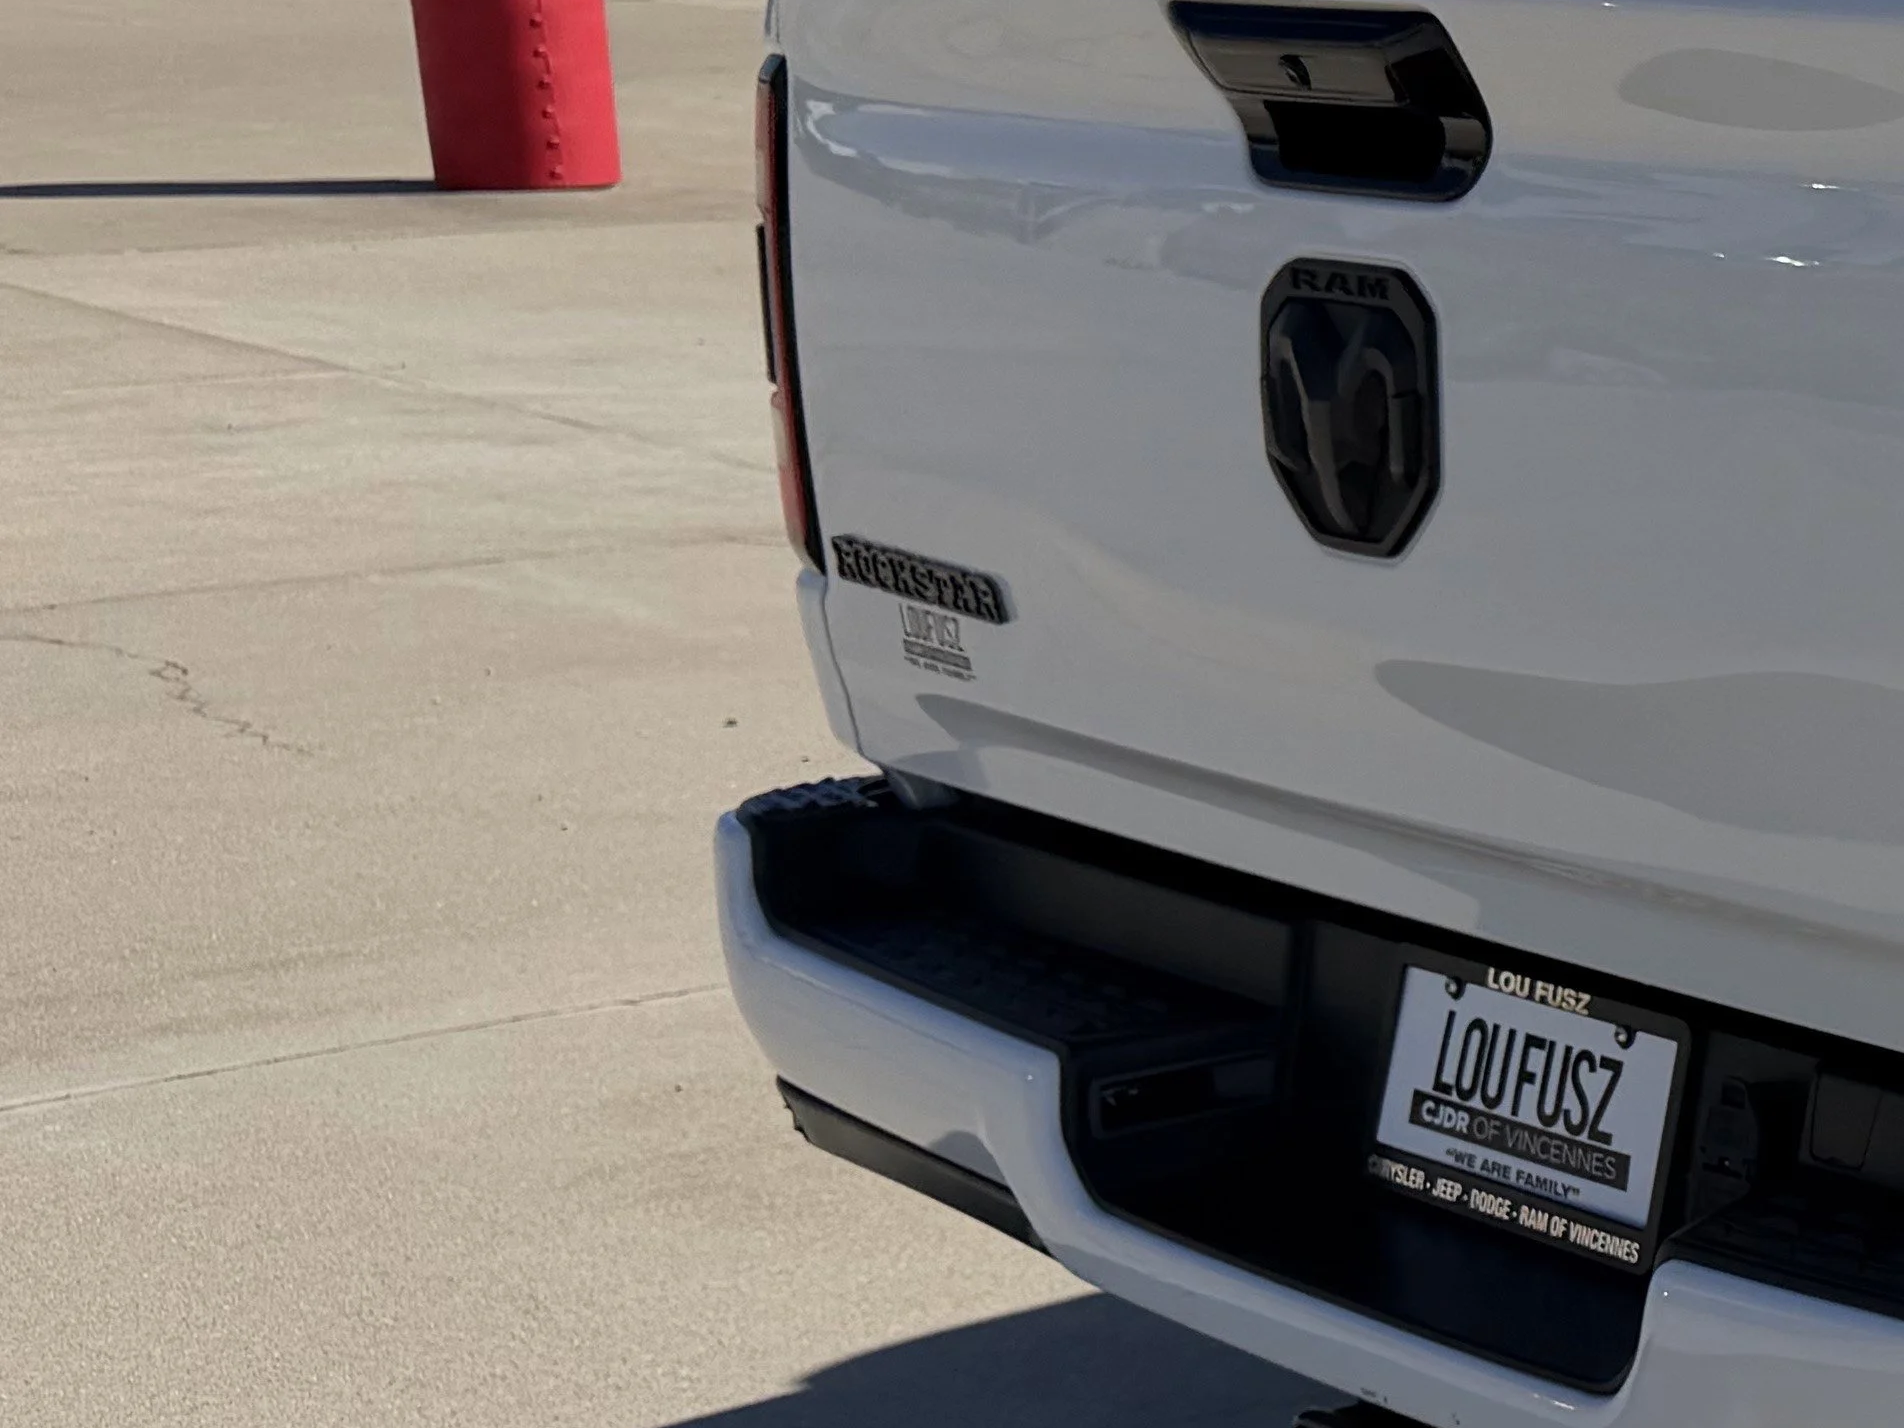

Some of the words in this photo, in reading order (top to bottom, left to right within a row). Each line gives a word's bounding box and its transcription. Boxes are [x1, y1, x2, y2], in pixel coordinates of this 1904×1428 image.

[1290, 266, 1390, 301] RAM
[832, 535, 1010, 625] ROCKSTAR
[1486, 967, 1530, 997] LOU
[1534, 981, 1592, 1016] FUSZ
[1420, 1099, 1469, 1132] CJDR
[1473, 1114, 1501, 1143] OF
[1505, 1123, 1616, 1180] VINCENNES
[1479, 1156, 1511, 1179] ARE
[1431, 1177, 1463, 1203] JEEP
[1469, 1188, 1512, 1220] DODGE
[1518, 1205, 1549, 1233] RAM
[1549, 1215, 1568, 1241] OF
[1568, 1220, 1640, 1264] VINCENNES
